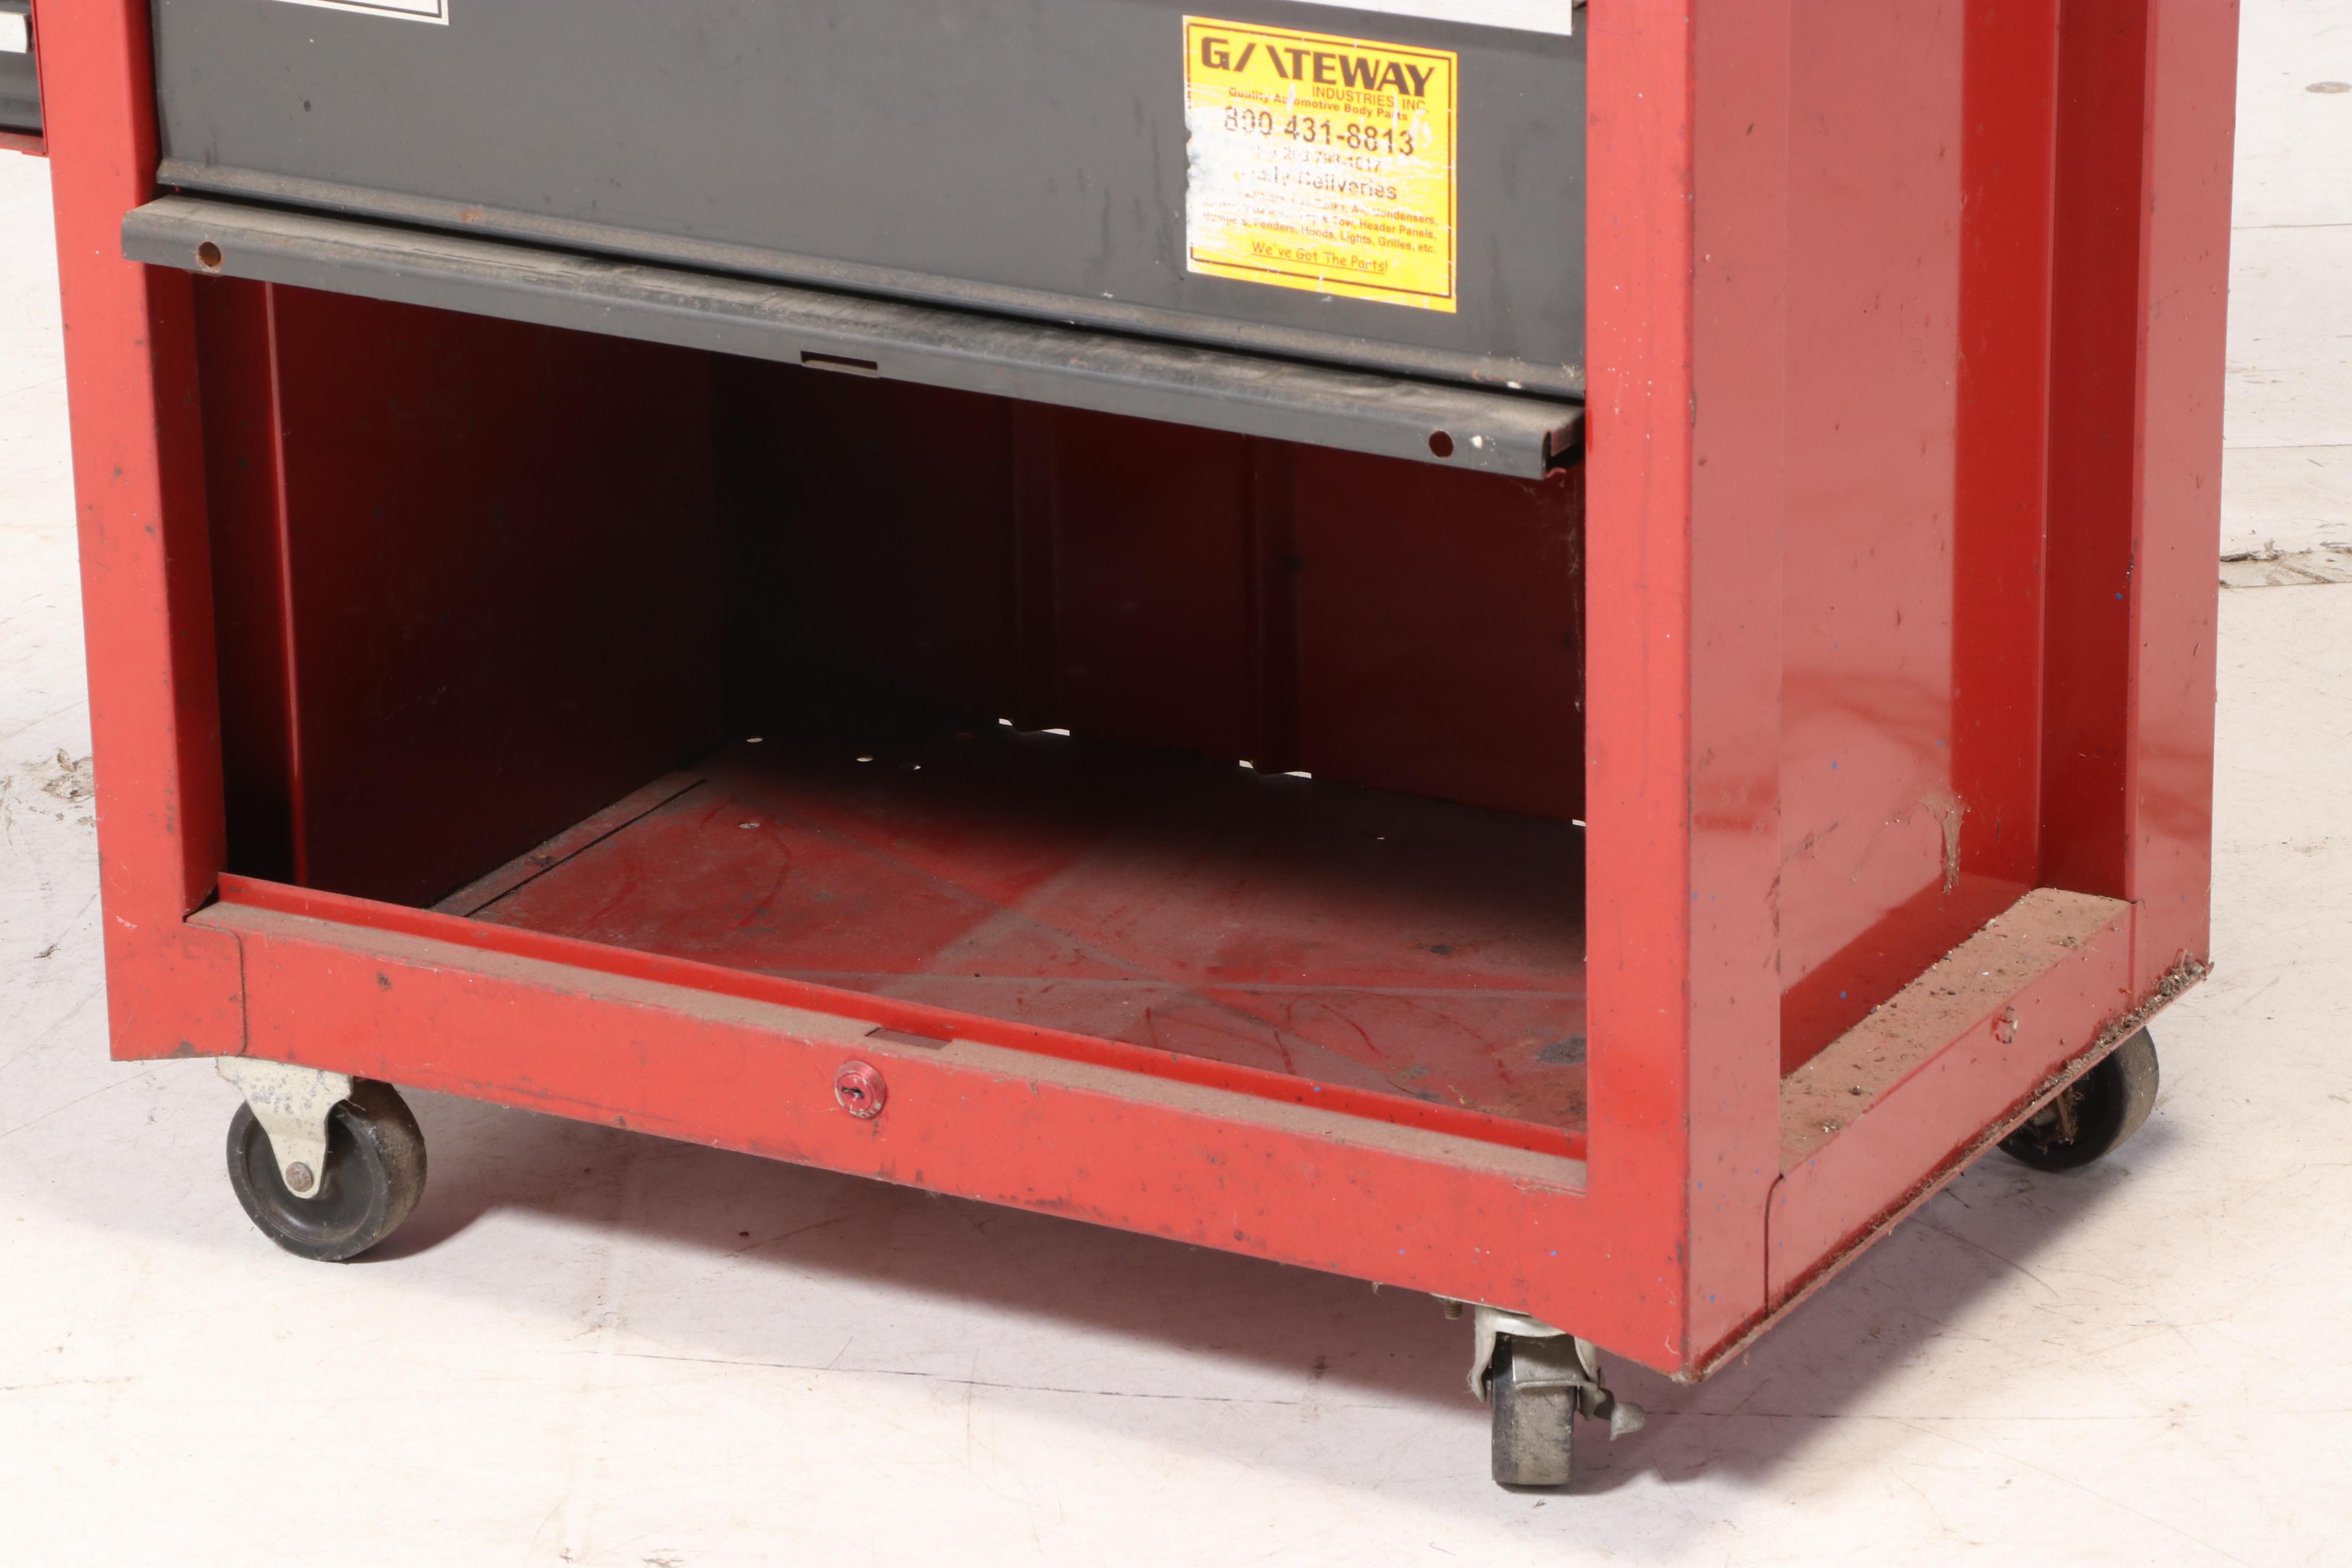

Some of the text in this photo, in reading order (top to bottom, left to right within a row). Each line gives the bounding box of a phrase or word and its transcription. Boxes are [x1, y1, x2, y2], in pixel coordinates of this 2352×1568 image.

[1201, 37, 1436, 96] GATEWAY
[1229, 88, 1270, 103] Quality
[1273, 93, 1340, 111] Auomotive
[1345, 103, 1373, 118] Body
[1312, 86, 1429, 113] INDUSTRIES INC.
[1224, 106, 1415, 157] 800 431-8813
[1301, 225, 1337, 240] Hoods,
[1341, 231, 1376, 245] Lights,
[1378, 236, 1415, 251] Grilles,
[1417, 243, 1437, 254] etc.
[1360, 219, 1396, 234] Header
[1399, 225, 1437, 240] Panels,
[1252, 241, 1388, 272] We've Got The Parts!
